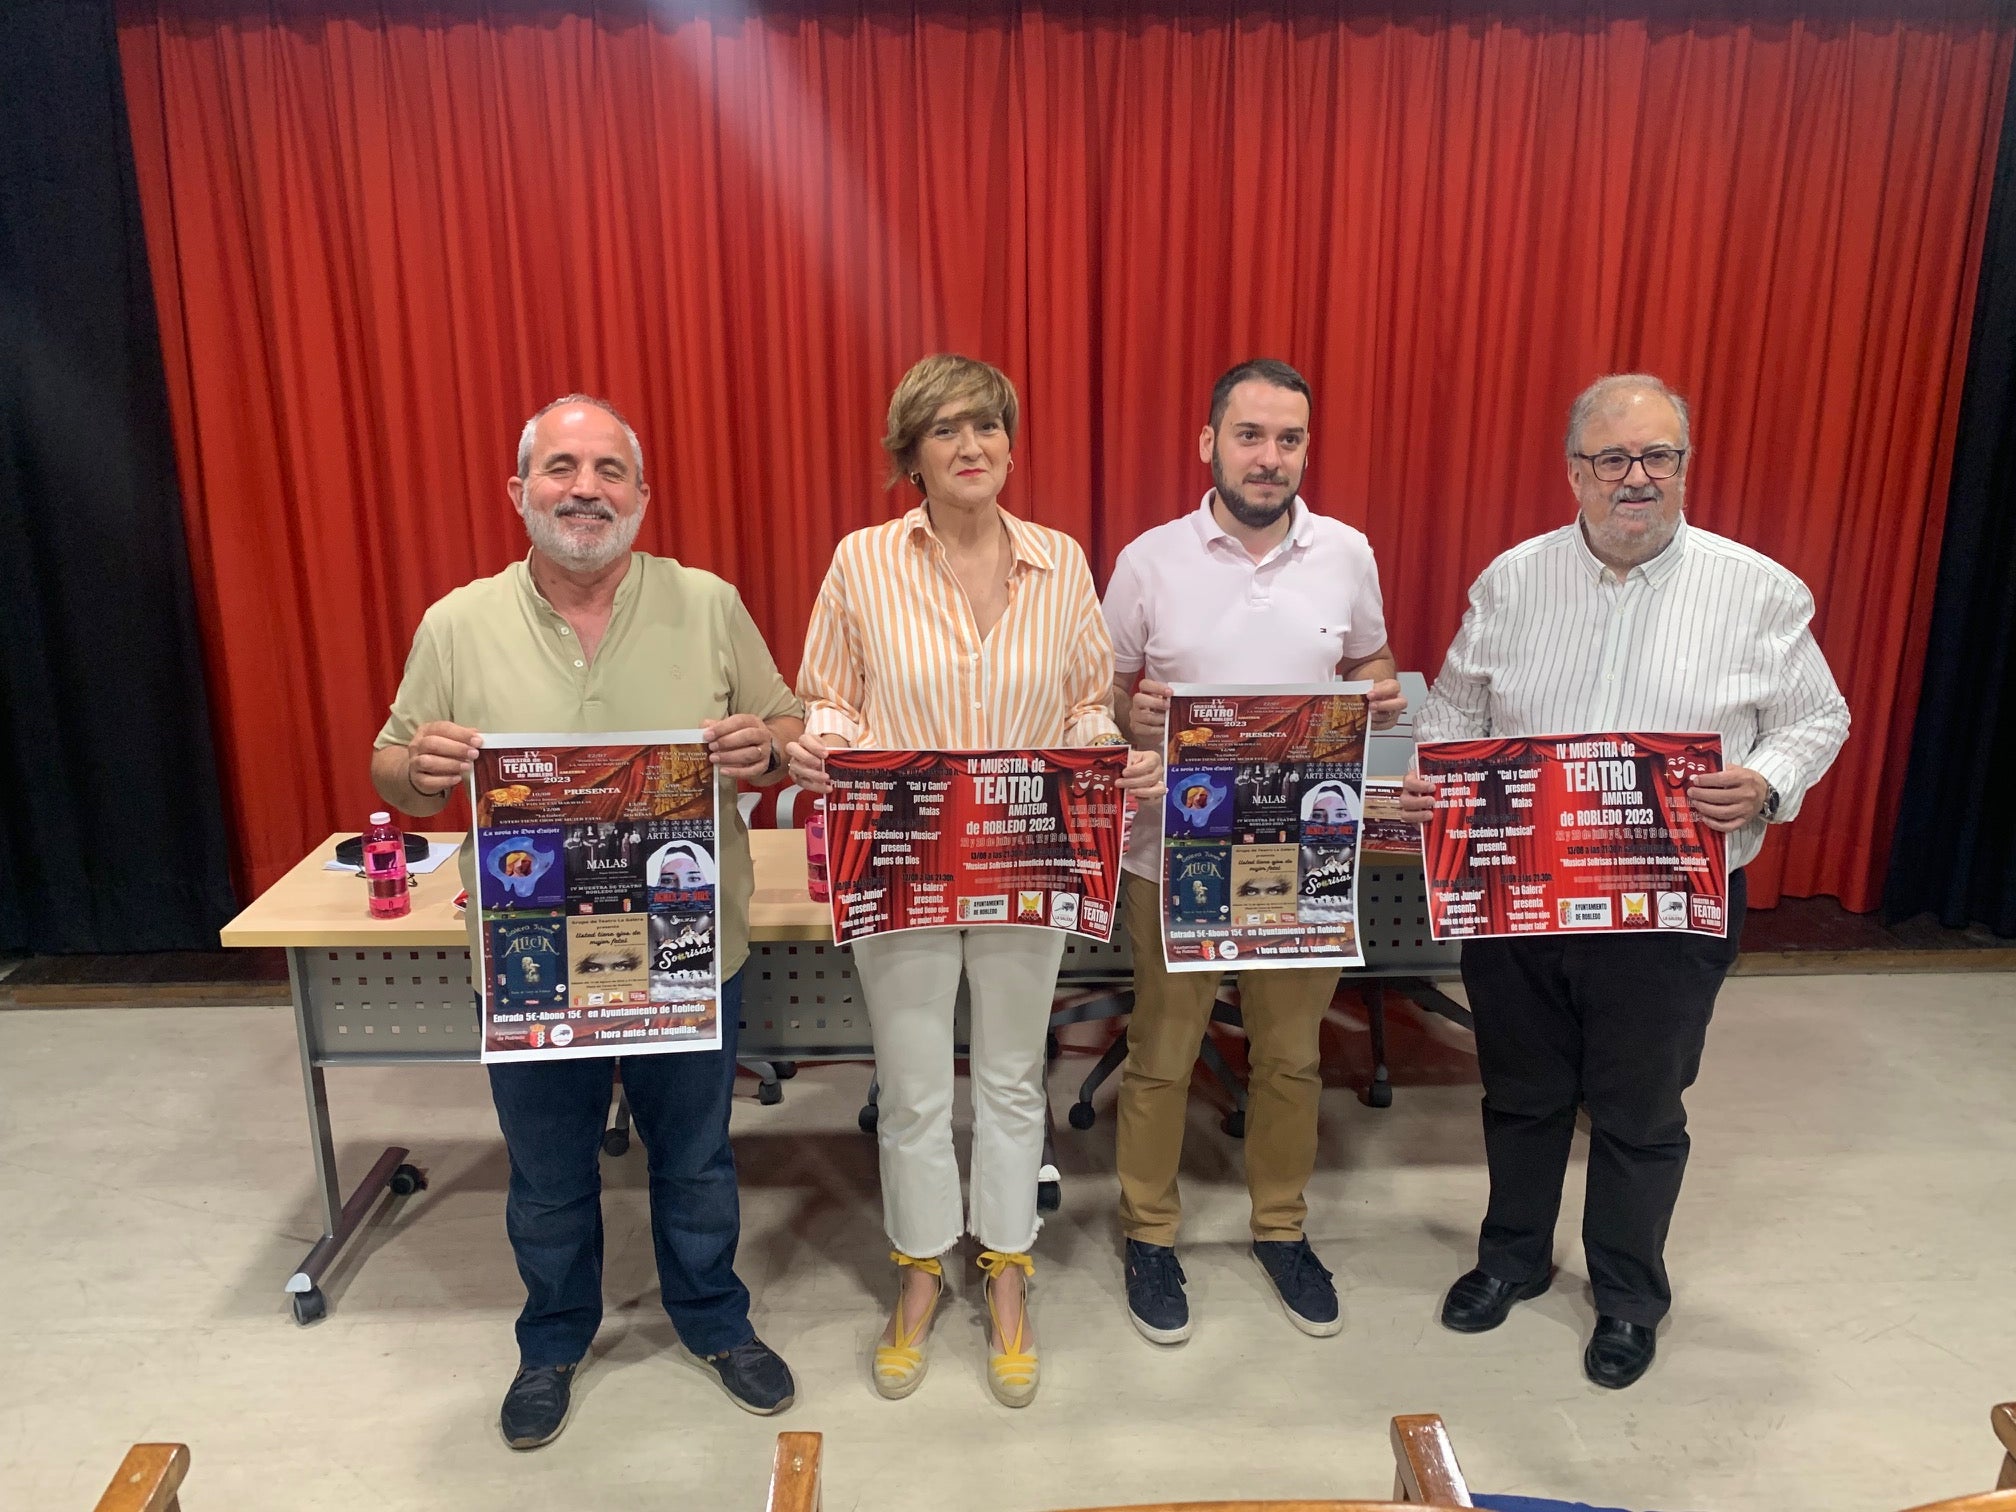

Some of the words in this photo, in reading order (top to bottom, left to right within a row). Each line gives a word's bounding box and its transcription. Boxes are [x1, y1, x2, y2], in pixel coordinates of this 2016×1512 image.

[1194, 709, 1234, 718] TEATRO
[1556, 743, 1566, 759] IV
[1569, 741, 1618, 759] MUESTRA
[1621, 741, 1635, 757] de
[503, 762, 553, 773] TEATRO
[967, 759, 978, 774] IV
[980, 758, 1028, 774] MUESTRA
[1031, 758, 1045, 772] de
[1448, 773, 1462, 783] Acto
[1464, 771, 1488, 782] Teatro"
[1497, 770, 1511, 780] "Cal
[1513, 771, 1517, 780] y
[1519, 768, 1541, 779] Canto"
[1563, 760, 1636, 792] TEATRO
[855, 781, 870, 789] Acto
[872, 781, 897, 790] Teatro"
[907, 781, 921, 790] "Cal
[922, 783, 926, 791] y
[928, 781, 951, 790] Canto"
[973, 776, 1044, 805] TEATRO
[1505, 783, 1535, 794] presenta
[847, 792, 877, 802] presenta
[1440, 786, 1470, 798] presenta
[914, 794, 944, 804] presenta
[1252, 795, 1286, 804] MALAS
[1450, 799, 1457, 807] de
[1466, 798, 1486, 807] Quijote
[1511, 798, 1532, 808] Malas
[1602, 791, 1643, 806] AMATEUR
[830, 803, 837, 811] La
[838, 802, 854, 811] novia
[856, 803, 864, 811] de
[872, 803, 893, 812] Quijote
[919, 806, 940, 816] Malas
[1008, 803, 1048, 817] AMATEUR
[1560, 811, 1574, 827] de
[1577, 810, 1622, 826] ROBLEDO
[1626, 809, 1653, 825] 2023
[966, 821, 979, 835] de
[982, 819, 1027, 835] ROBLEDO
[1029, 817, 1056, 831] 2023
[647, 832, 670, 840] ARTE
[672, 830, 714, 839] ESCÉNICO
[850, 830, 872, 840] "Artes
[874, 830, 904, 840] Escénico
[905, 832, 909, 840] y
[911, 831, 941, 840] Musical"
[1446, 829, 1467, 839] "Artes
[1469, 828, 1498, 838] Escénico
[1500, 829, 1504, 838] y
[1505, 825, 1535, 836] Musical"
[881, 843, 911, 854] presenta
[1477, 841, 1507, 853] presenta
[587, 859, 627, 869] MALAS
[873, 856, 894, 866] Agnes
[895, 856, 903, 865] de
[905, 856, 919, 865] Dios
[1053, 858, 1076, 866] Robledo
[1469, 856, 1490, 867] Agnes
[1492, 856, 1500, 865] de
[1501, 855, 1516, 865] Dios
[1647, 856, 1654, 865] de
[1656, 856, 1679, 865] Robledo
[910, 883, 922, 892] "La
[923, 883, 947, 892] Galera"
[1509, 885, 1520, 895] "La
[1522, 884, 1546, 894] Galera"
[839, 892, 861, 905] "Galera
[863, 888, 886, 900] Junior"
[914, 895, 944, 906] presenta
[1435, 892, 1460, 902] "Galera
[1461, 890, 1485, 901] Junior"
[849, 902, 877, 917] presenta
[973, 900, 1004, 908] AYUNTAMIENTO
[1447, 903, 1476, 915] presenta
[1513, 898, 1544, 910] presenta
[1575, 903, 1607, 911] AYUNTAMIENTO
[1083, 906, 1109, 922] TEATRO
[1694, 904, 1721, 919] TEATRO
[1170, 931, 1196, 939] Entrada
[1197, 929, 1229, 938] 5€-Abono
[1258, 927, 1305, 936] Ayuntamiento
[1317, 926, 1345, 934] Robledo
[1279, 946, 1299, 954] antes
[1311, 944, 1342, 953] taquillas.
[493, 1013, 524, 1023] Entrada
[526, 1012, 565, 1021] 5€-Abono
[567, 1010, 582, 1018] 15€
[588, 1010, 598, 1018] en
[601, 1006, 657, 1018] Ayuntamiento
[660, 1006, 670, 1014] de
[672, 1004, 705, 1013] Robledo
[644, 1018, 650, 1026] y
[601, 1030, 620, 1038] hora
[622, 1028, 646, 1038] antes
[648, 1028, 658, 1036] en
[661, 1026, 699, 1036] taquillas.
